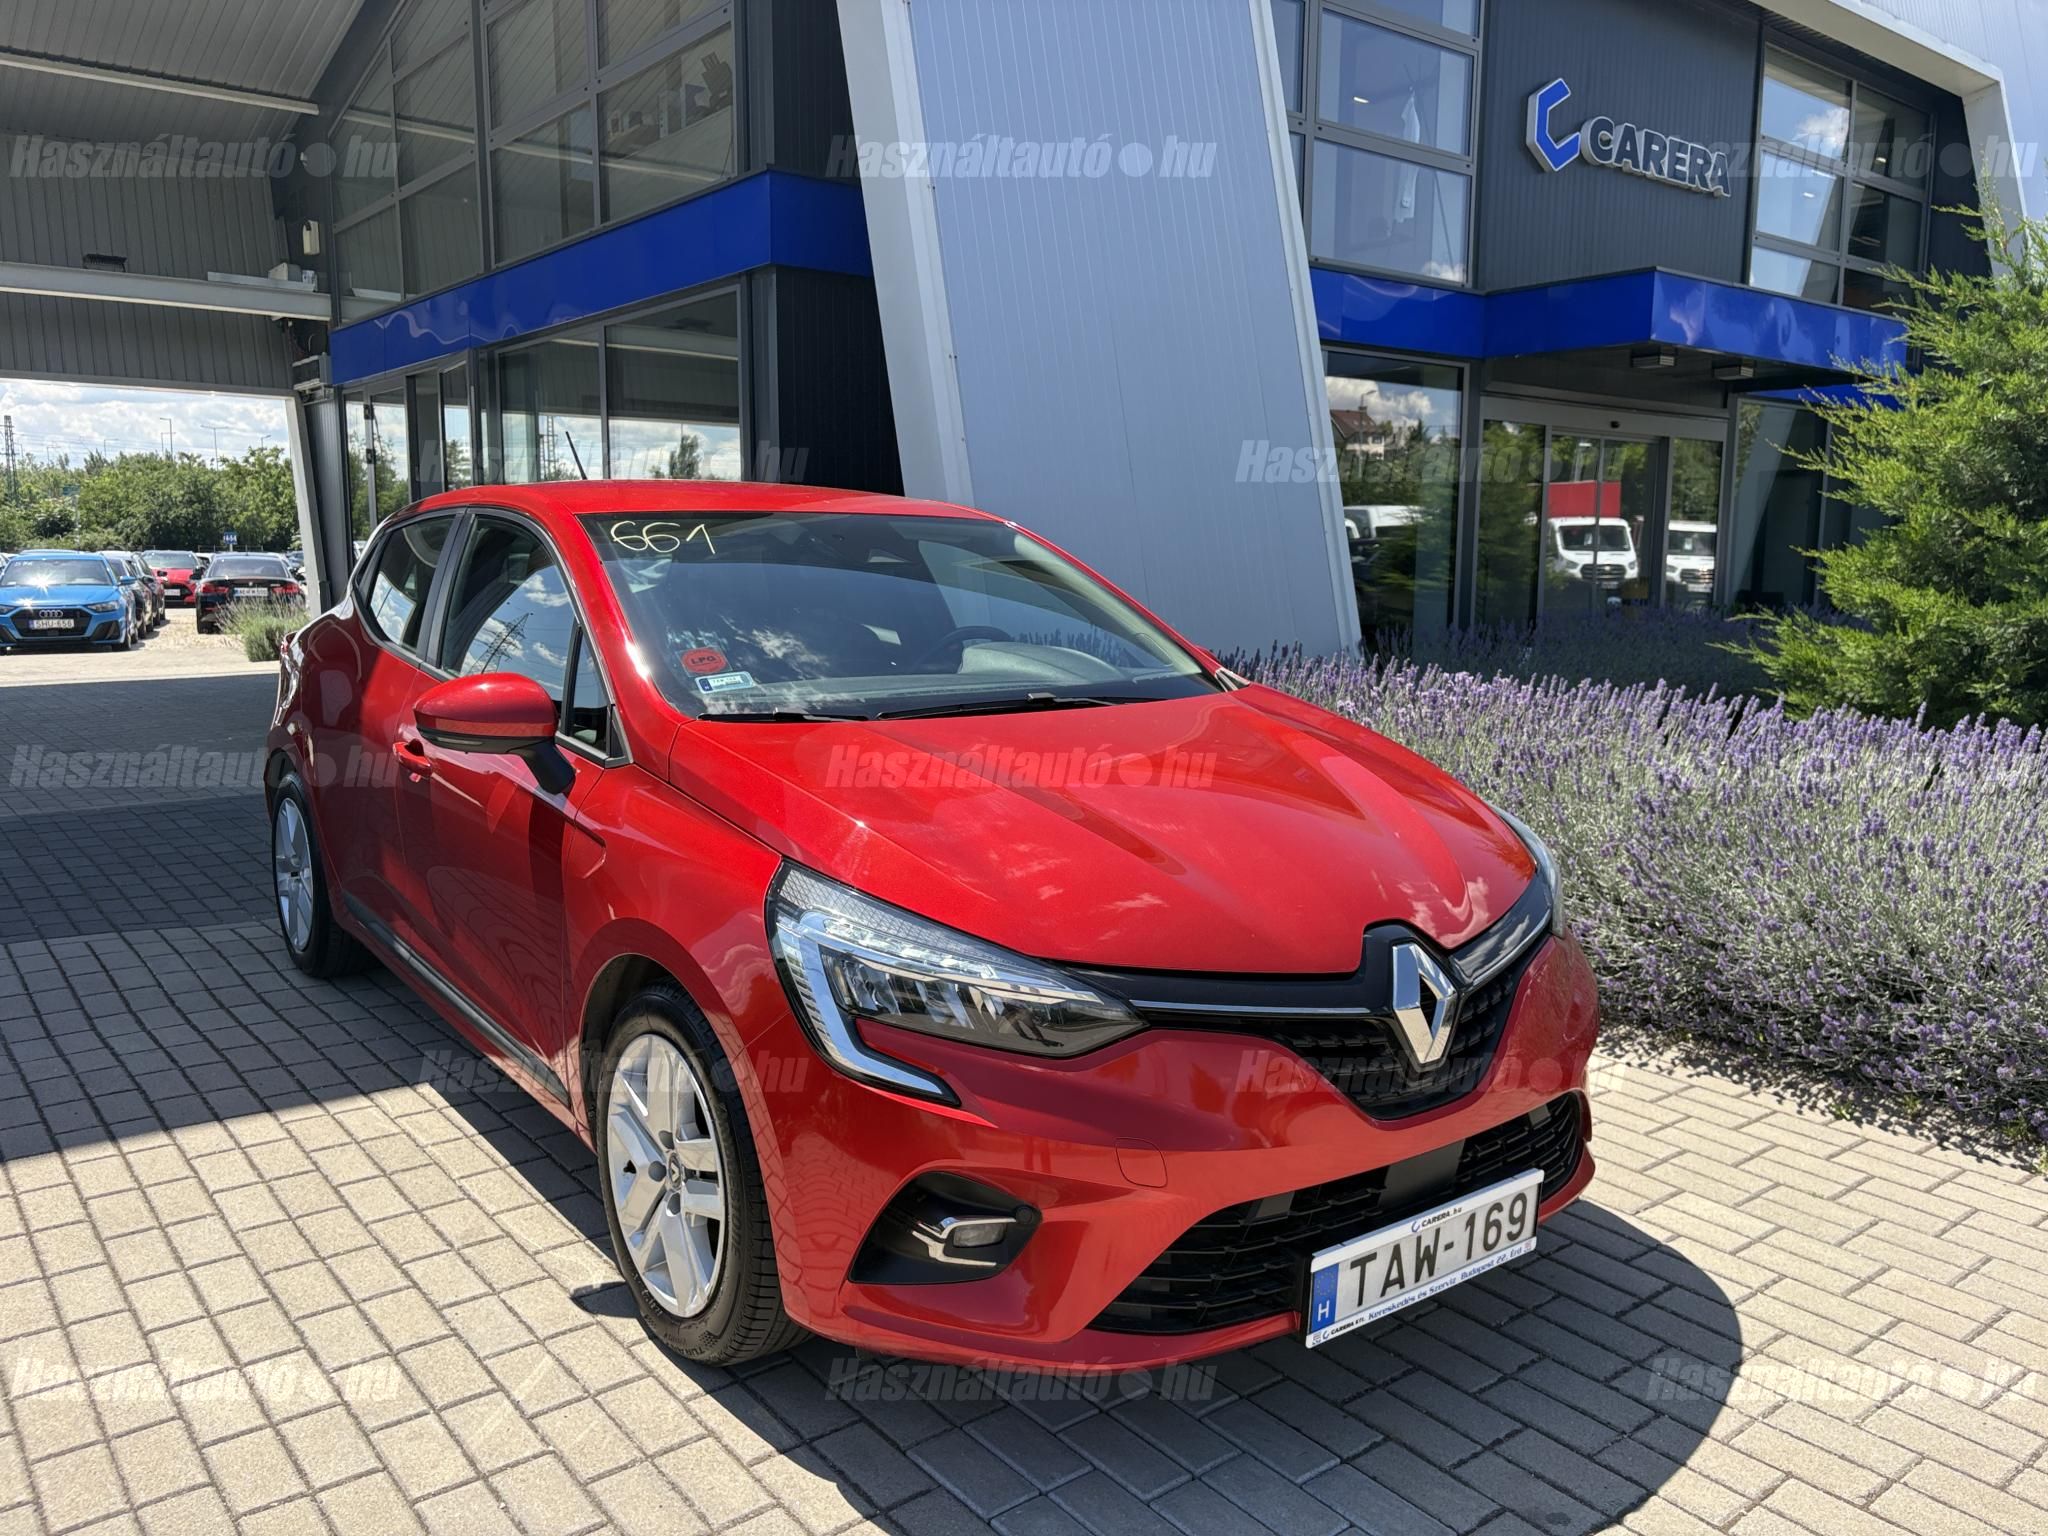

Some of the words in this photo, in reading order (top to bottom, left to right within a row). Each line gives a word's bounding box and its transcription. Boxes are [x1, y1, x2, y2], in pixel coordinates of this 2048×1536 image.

[1582, 116, 1731, 198] CARERA
[610, 520, 716, 555] 661
[1350, 1192, 1528, 1307] TAW-169
[1317, 1300, 1330, 1322] H
